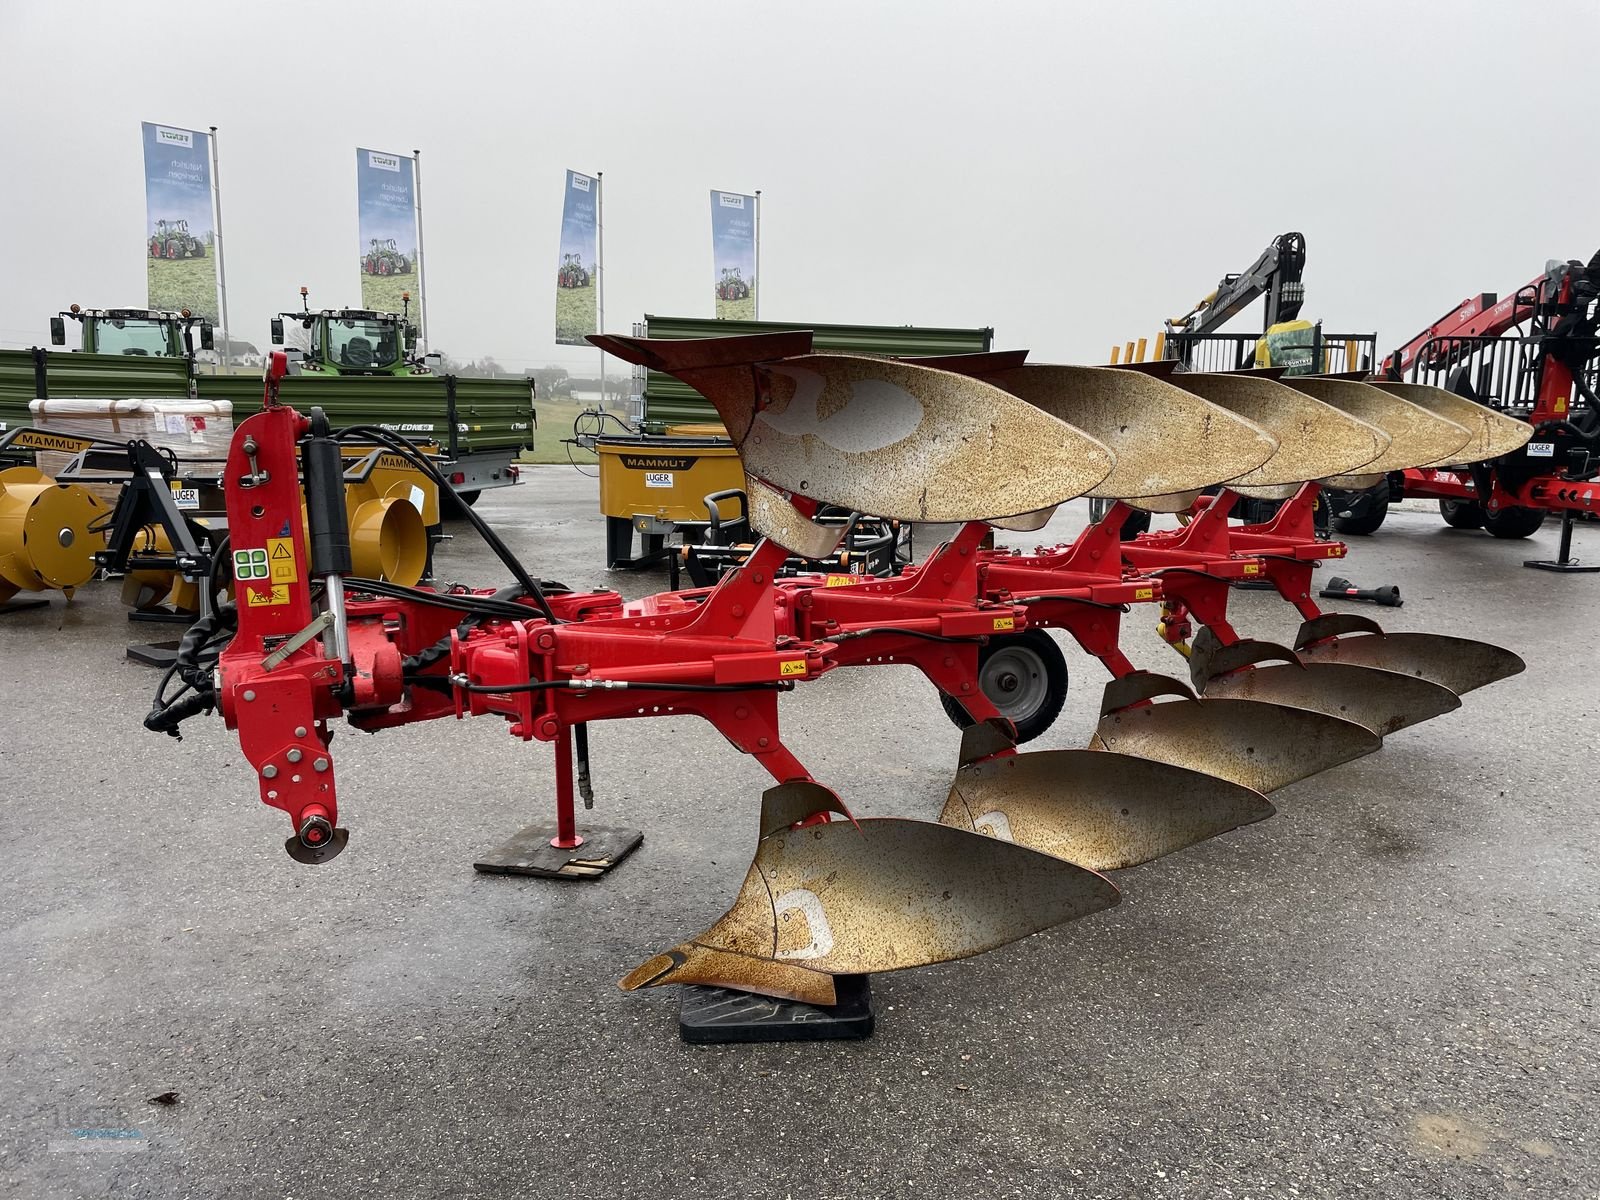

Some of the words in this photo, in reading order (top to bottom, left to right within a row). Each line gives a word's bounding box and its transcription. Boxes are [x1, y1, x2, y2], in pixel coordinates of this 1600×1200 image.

[22, 433, 83, 451] MAMMUT
[627, 458, 687, 468] MAMMUT
[646, 473, 669, 482] LUGER
[172, 489, 196, 501] LUGER
